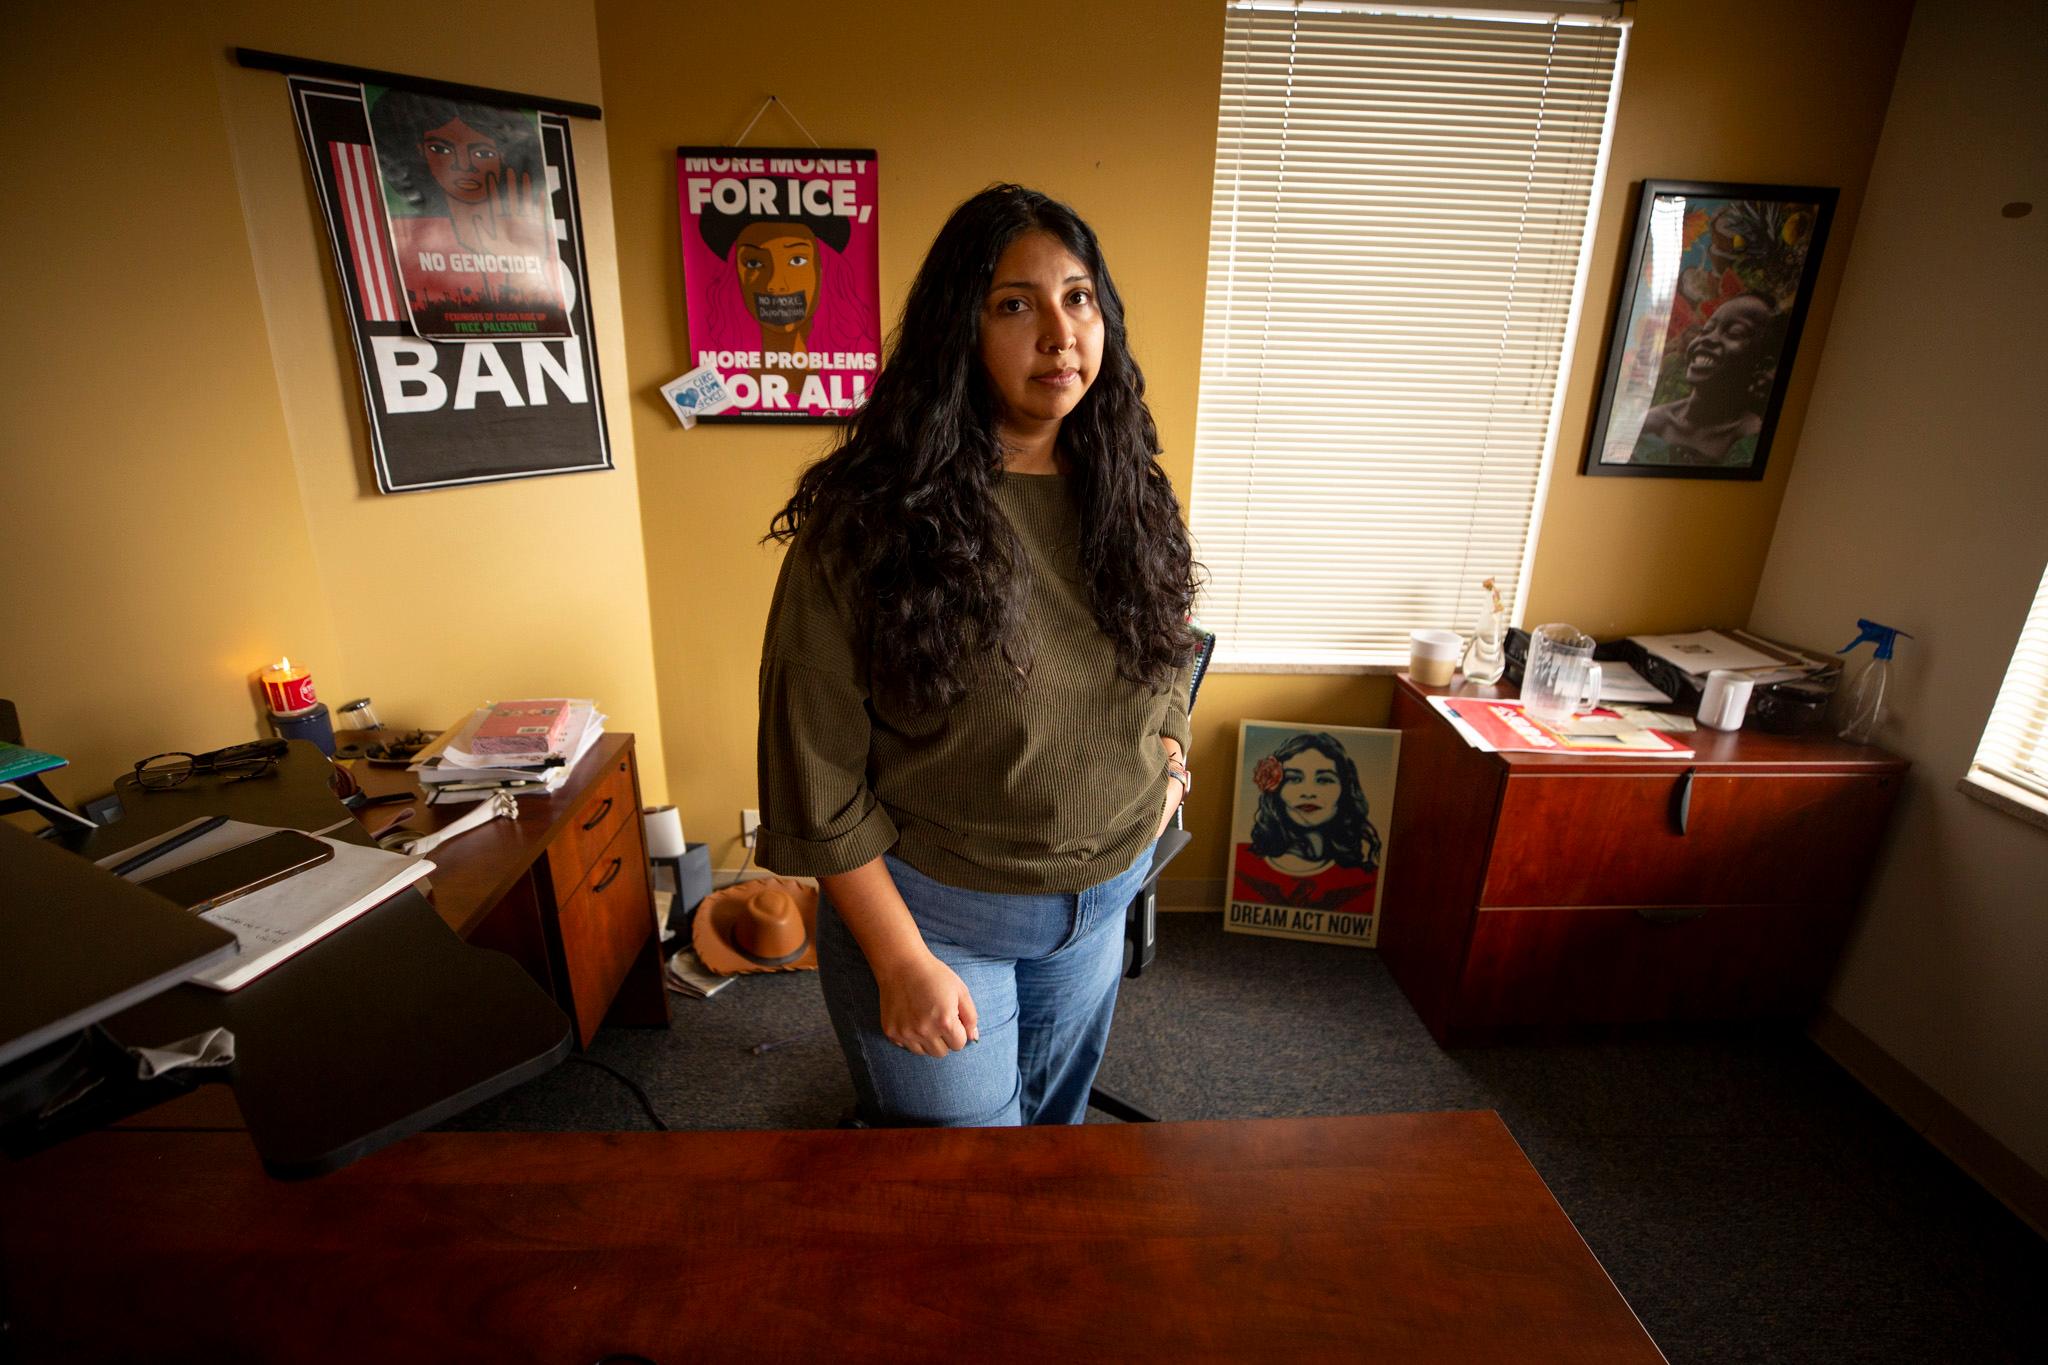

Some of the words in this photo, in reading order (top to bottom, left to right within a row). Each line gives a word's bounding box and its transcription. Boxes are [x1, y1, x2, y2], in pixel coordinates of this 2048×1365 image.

[685, 157, 765, 173] MORE
[770, 158, 867, 174] MONEY
[688, 177, 780, 215] FOR
[787, 178, 872, 224] ICE,
[418, 252, 447, 272] NO
[451, 253, 542, 273] GENOCIDE!
[454, 322, 481, 332] FREE
[482, 322, 538, 332] PALESTINE!
[699, 350, 761, 369] MORE
[765, 351, 877, 370] PROBLEMS
[370, 334, 589, 414] BAN
[721, 373, 791, 409] OR
[1231, 903, 1288, 927] DREAM
[1291, 911, 1324, 931] ACT
[1327, 915, 1374, 937] NOW!
